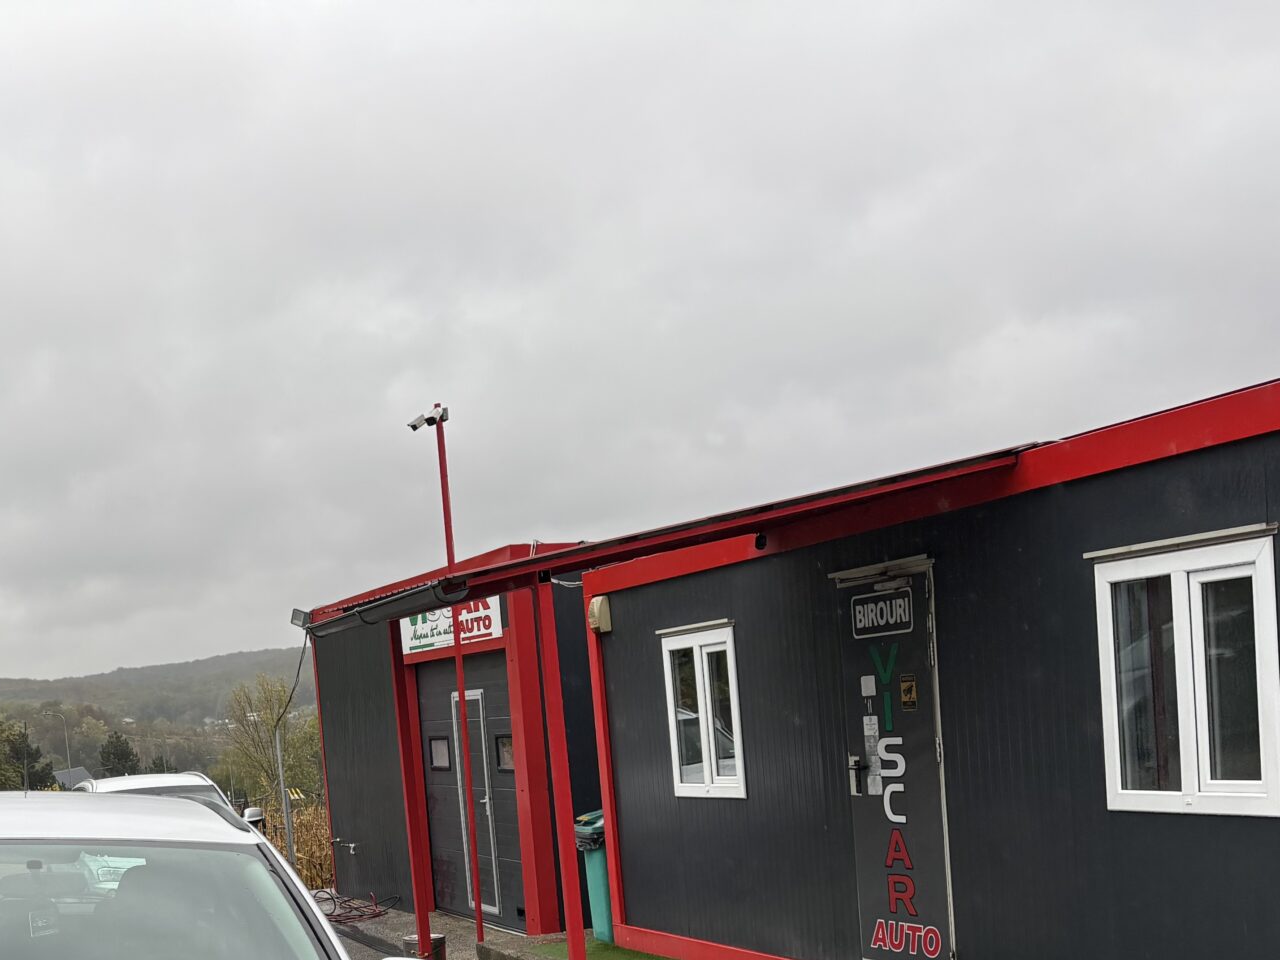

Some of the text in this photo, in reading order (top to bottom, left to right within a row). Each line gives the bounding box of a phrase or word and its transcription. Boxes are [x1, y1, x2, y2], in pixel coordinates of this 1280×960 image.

[460, 615, 492, 635] AUTO
[855, 597, 910, 628] BIROURI
[871, 919, 941, 958] AUTO
